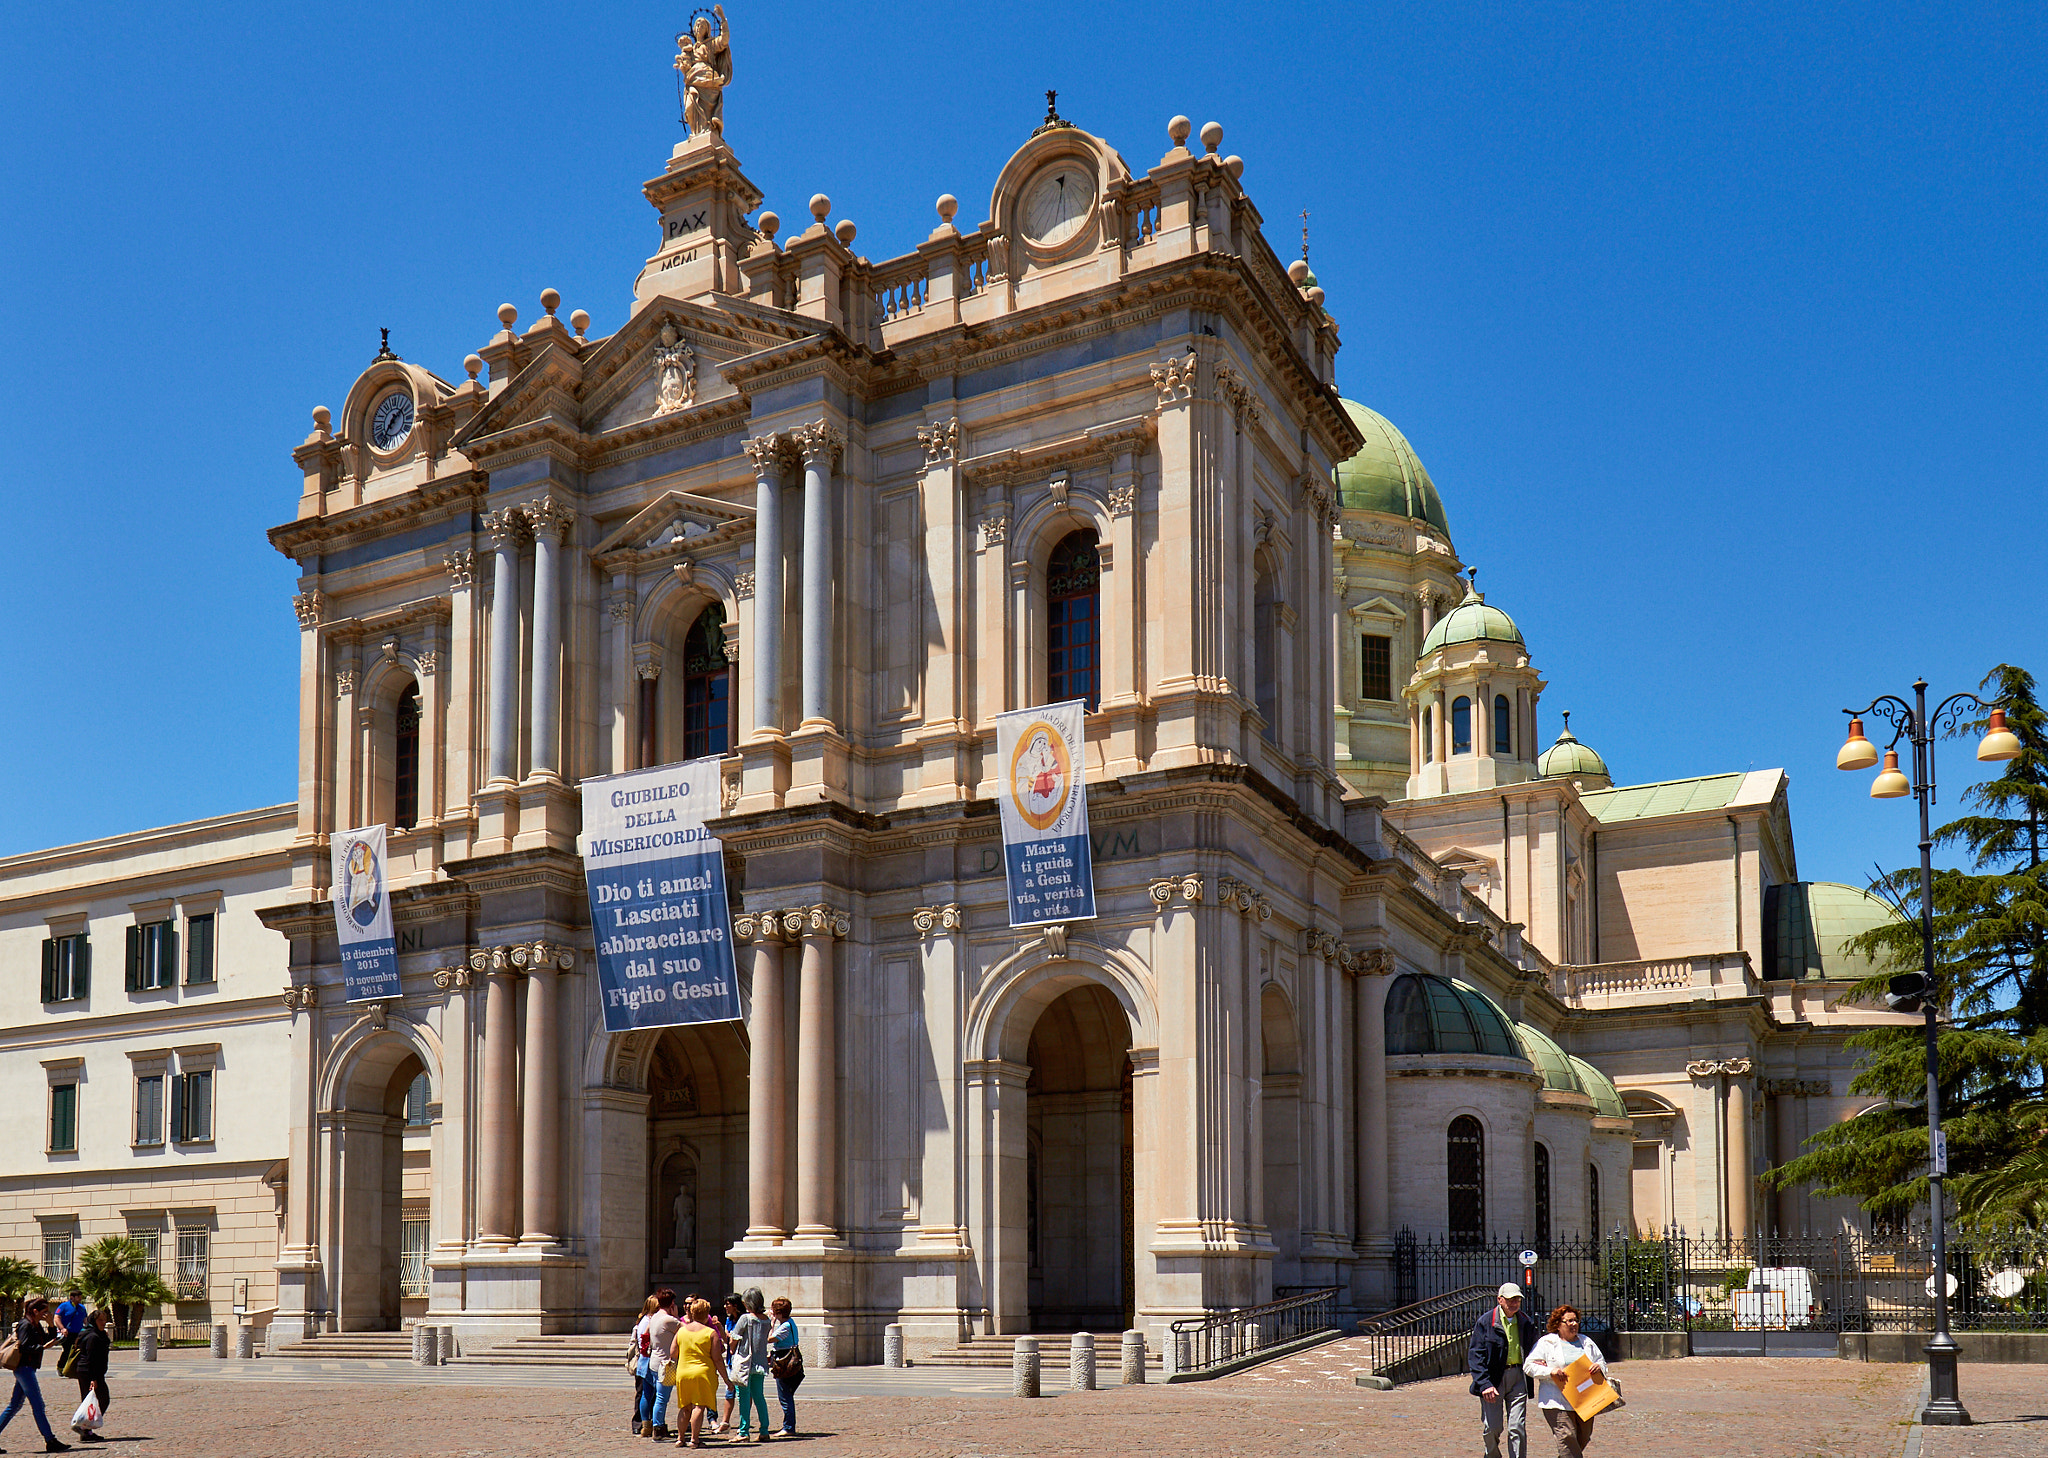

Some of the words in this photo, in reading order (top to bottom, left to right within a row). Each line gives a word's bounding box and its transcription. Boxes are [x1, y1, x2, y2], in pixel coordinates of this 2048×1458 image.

[669, 210, 707, 237] PAX
[661, 249, 697, 271] MCMI
[1040, 711, 1068, 734] MADRE
[610, 782, 691, 808] GIUBILEO
[624, 808, 677, 829] DELLA
[590, 827, 715, 858] MISERICORDIA
[1025, 842, 1067, 857] Maria
[1020, 860, 1032, 873] ti
[1035, 856, 1074, 875] guida
[597, 883, 632, 905] Dio
[637, 879, 654, 899] ti
[660, 870, 712, 896] ama!
[1025, 877, 1034, 888] a
[1037, 871, 1072, 887] Gesù
[1016, 892, 1041, 905] via,
[1044, 885, 1085, 901] verità
[614, 898, 700, 927] Lasciati
[1033, 908, 1041, 918] e
[1044, 903, 1071, 917] vita
[600, 926, 724, 956] abbracciare
[341, 951, 352, 962] 13
[353, 945, 395, 960] dicembre
[356, 958, 379, 970] 2015
[625, 957, 657, 979] dal
[663, 956, 702, 975] suo
[345, 977, 355, 987] 13
[356, 972, 398, 985] novembre
[360, 985, 384, 996] 2016
[608, 982, 667, 1010] Figlio
[672, 976, 729, 1001] Gesù
[1524, 1251, 1533, 1259] P
